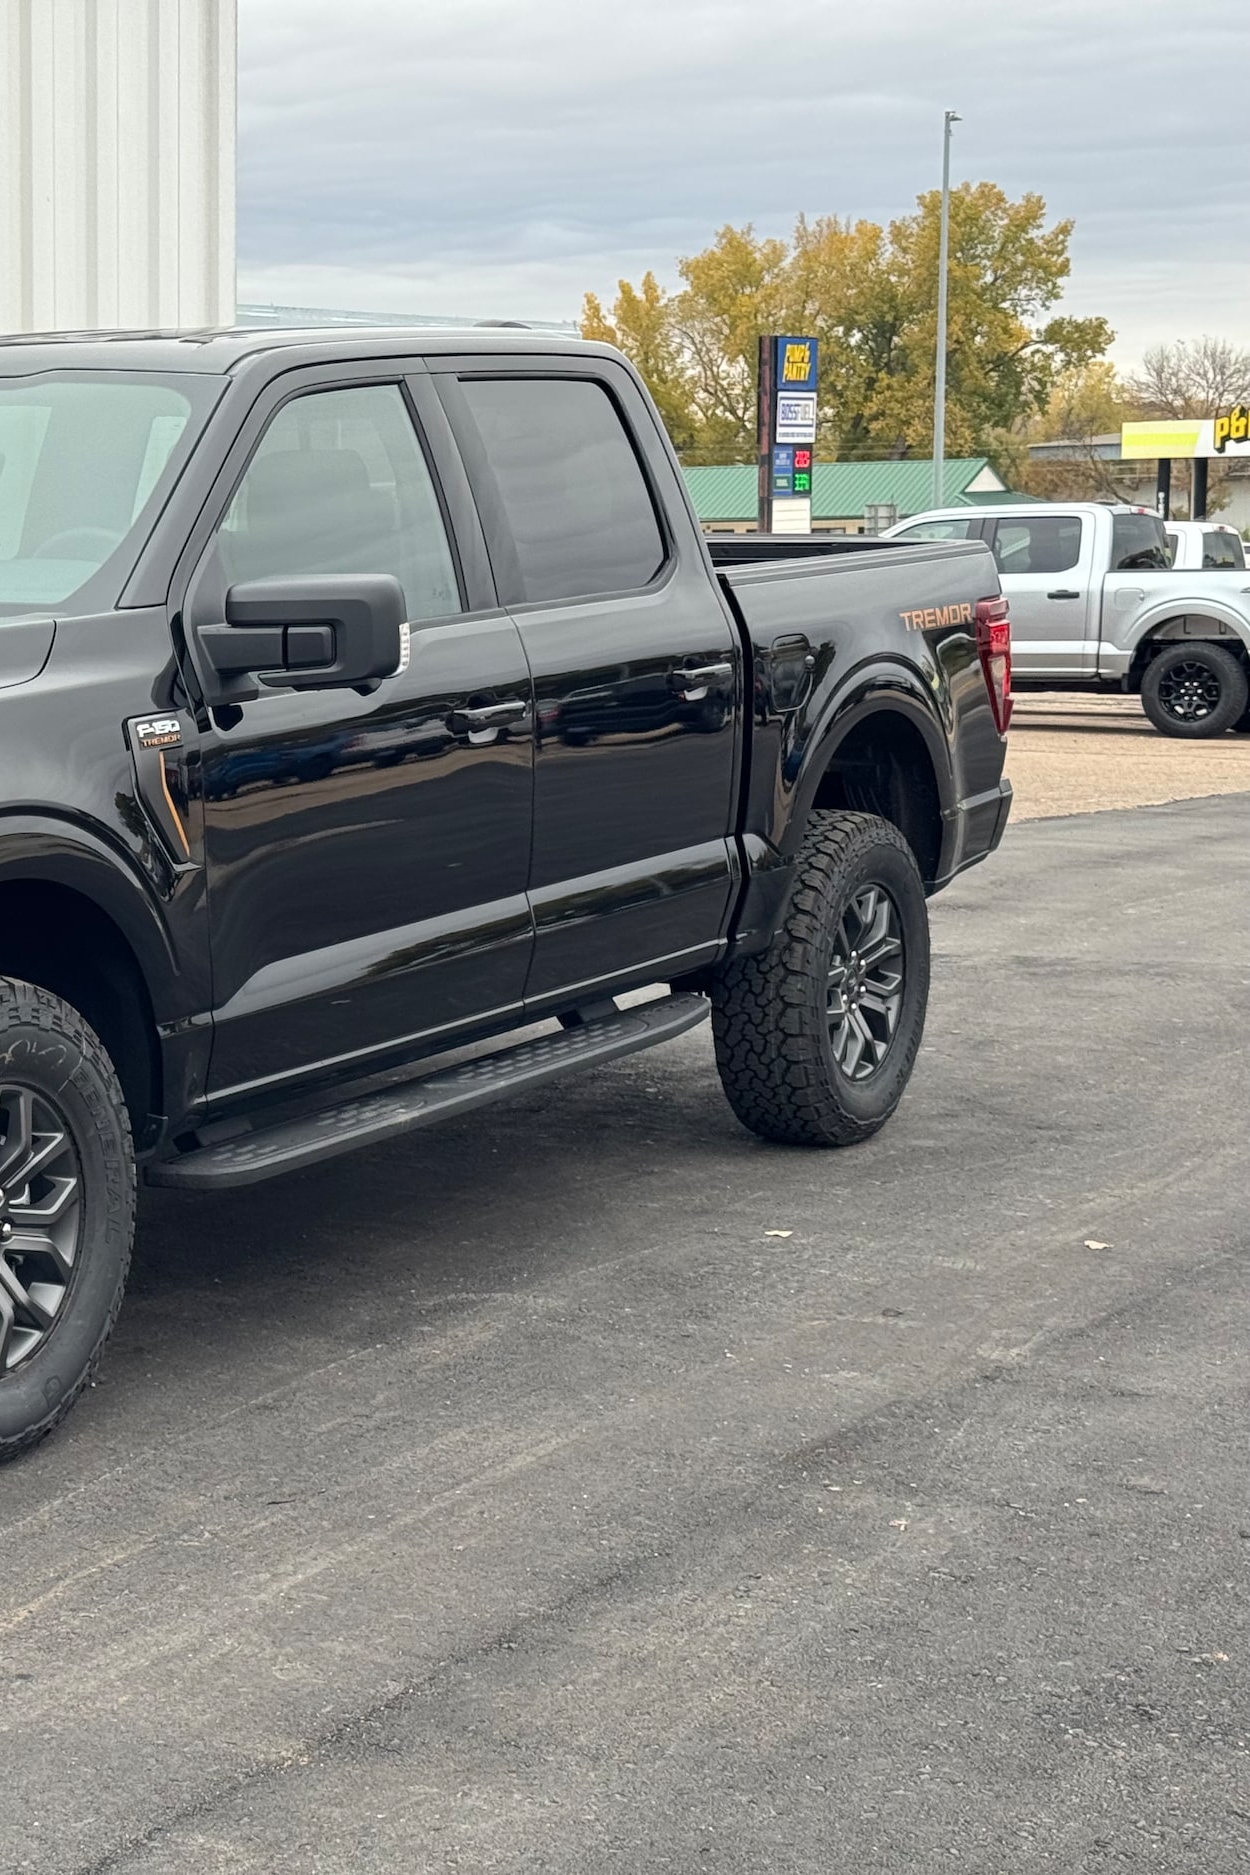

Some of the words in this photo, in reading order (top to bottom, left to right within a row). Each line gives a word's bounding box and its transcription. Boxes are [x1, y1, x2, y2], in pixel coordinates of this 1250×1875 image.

[899, 603, 974, 632] TREMOR
[137, 720, 181, 738] F-150
[141, 733, 182, 748] TREMOR
